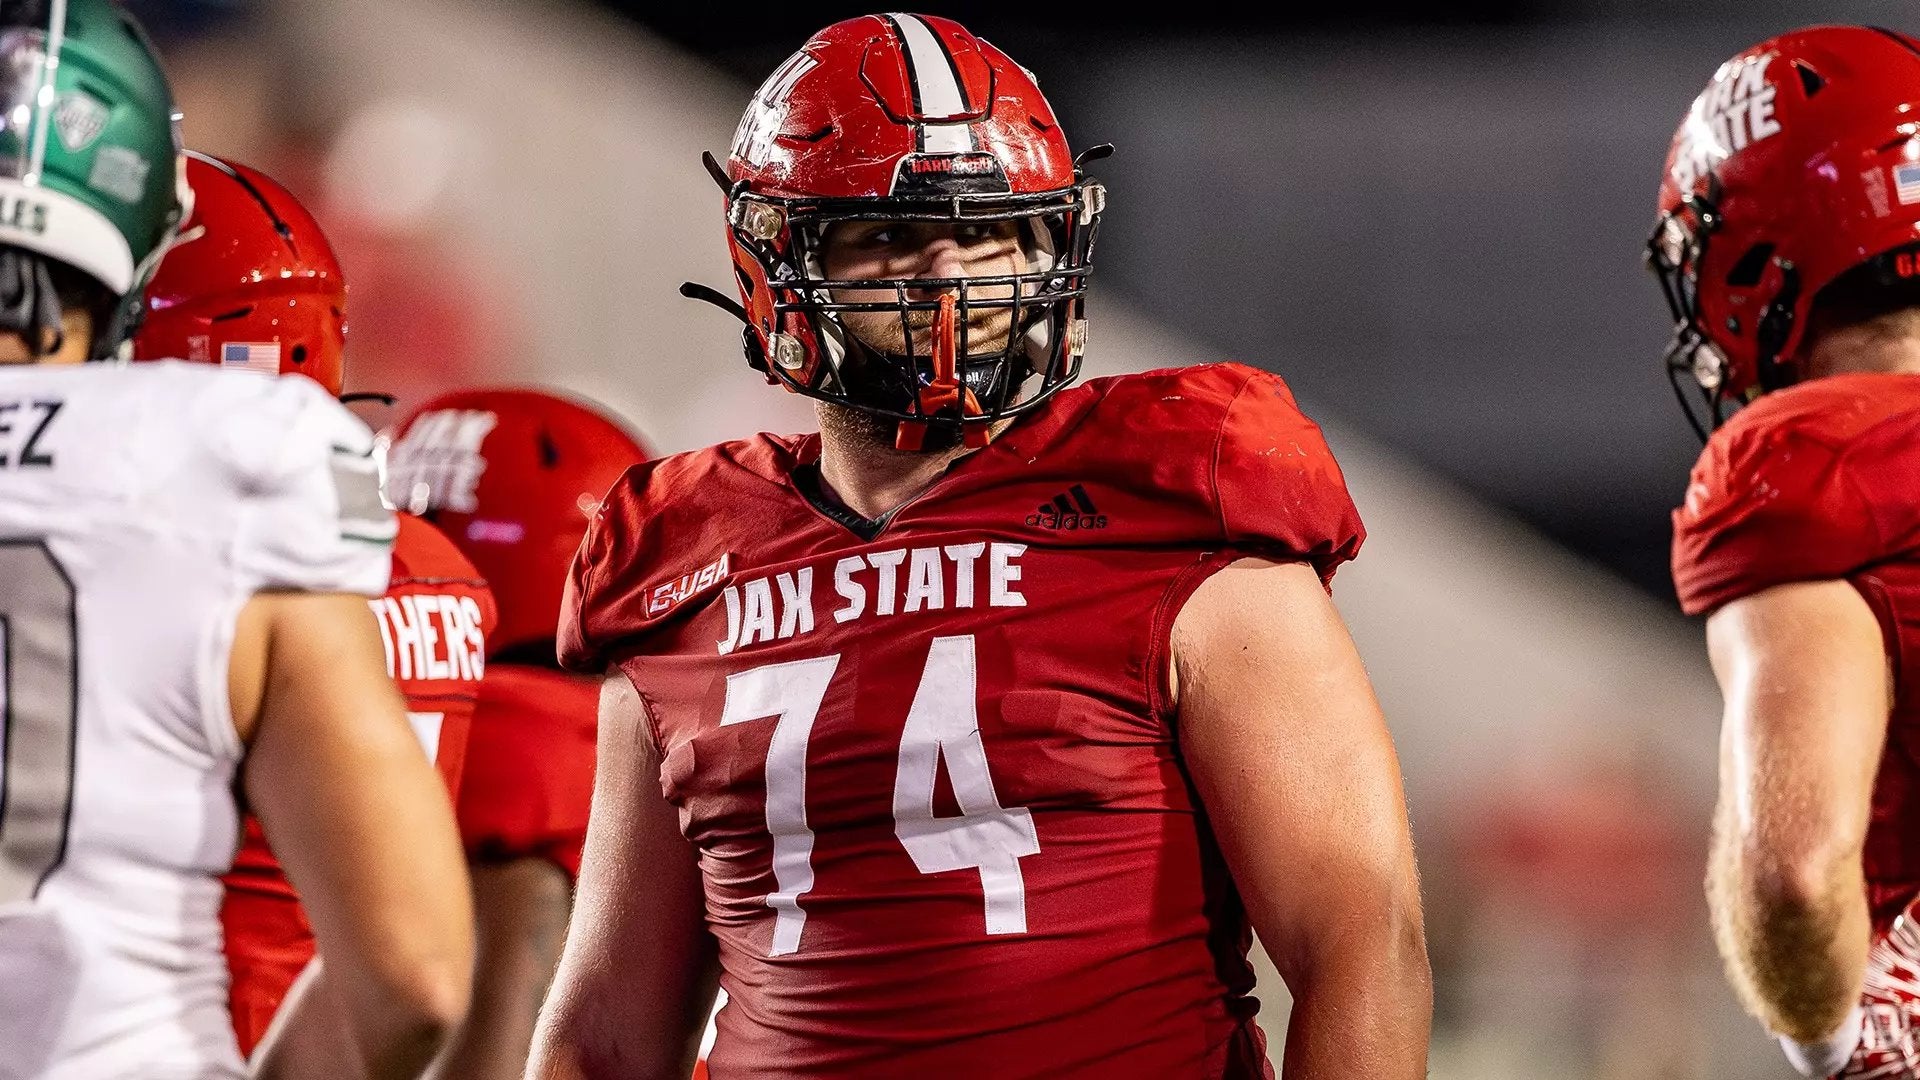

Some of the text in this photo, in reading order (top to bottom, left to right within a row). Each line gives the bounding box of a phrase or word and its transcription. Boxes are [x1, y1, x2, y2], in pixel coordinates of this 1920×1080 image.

[1025, 511, 1108, 531] adidas
[716, 542, 1028, 655] JAX STATE
[720, 634, 1042, 957] 74
